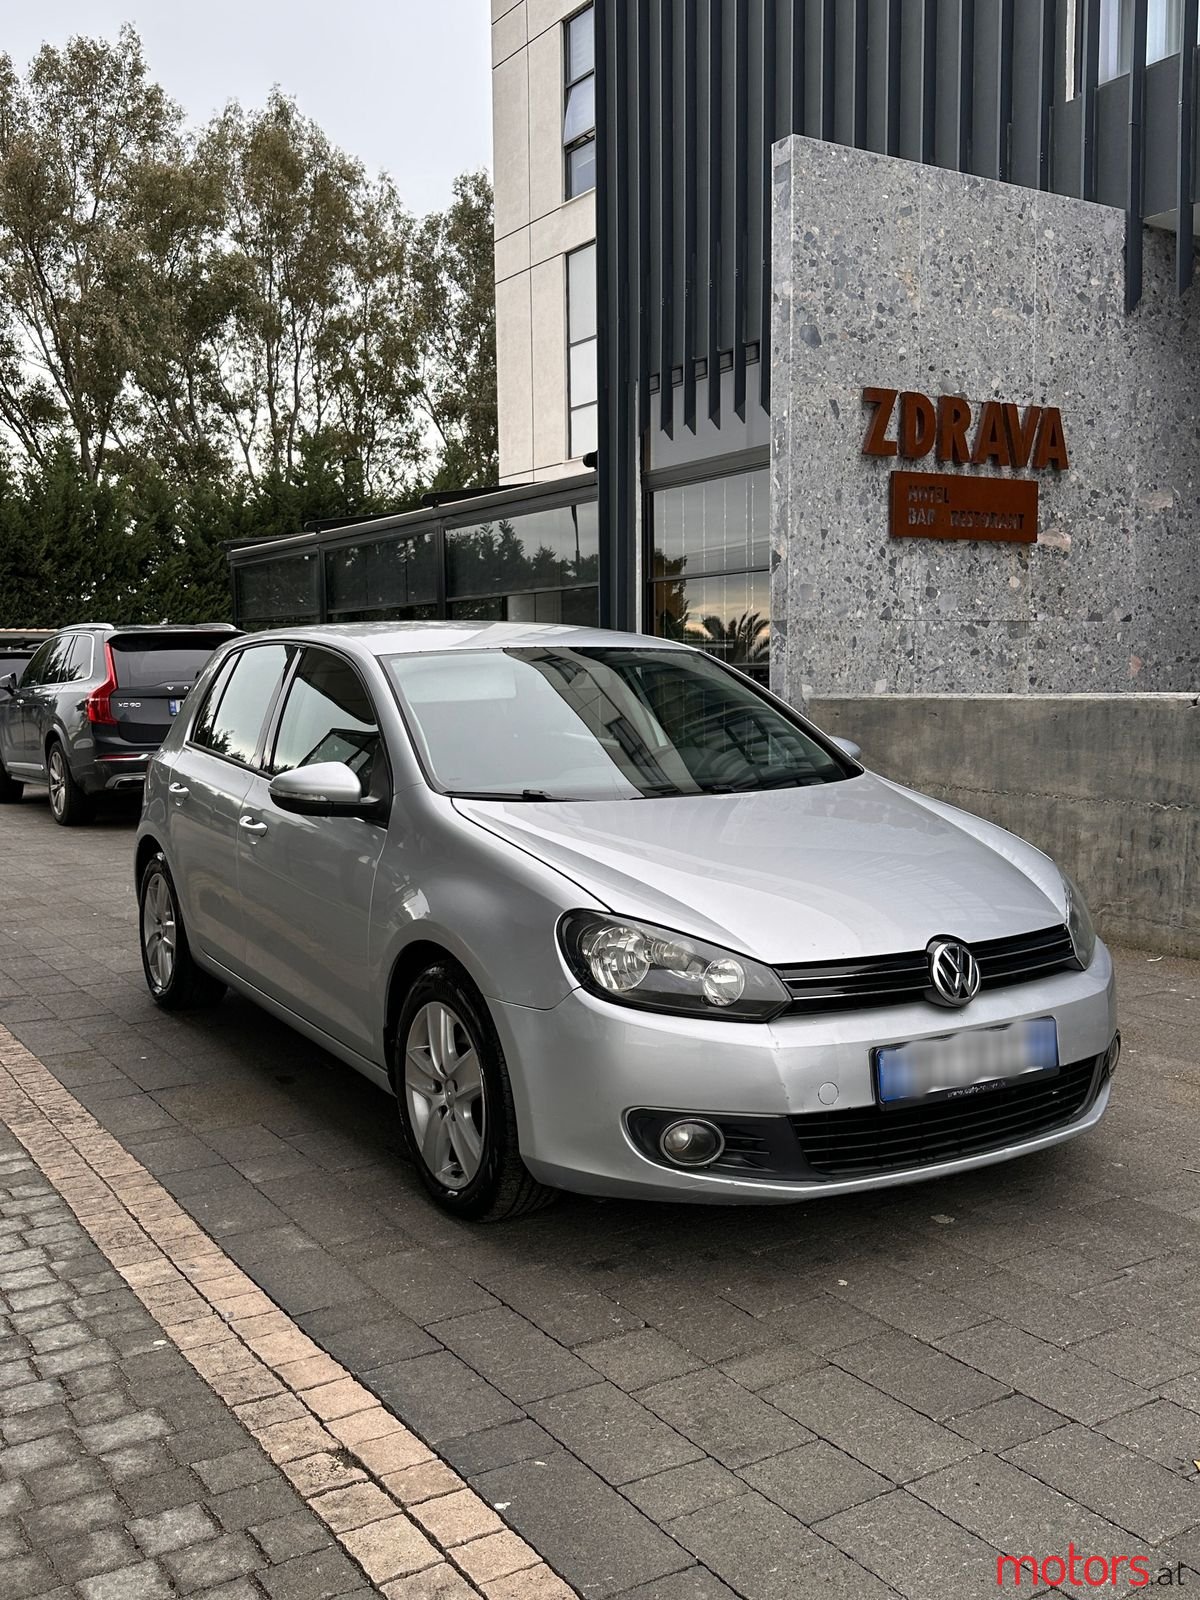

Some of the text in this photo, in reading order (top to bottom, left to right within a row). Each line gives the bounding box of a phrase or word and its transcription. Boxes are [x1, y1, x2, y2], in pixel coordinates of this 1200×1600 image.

[862, 386, 1069, 470] ZDRAVA
[907, 484, 950, 505] HOTEL
[950, 510, 1025, 530] RESTORANT
